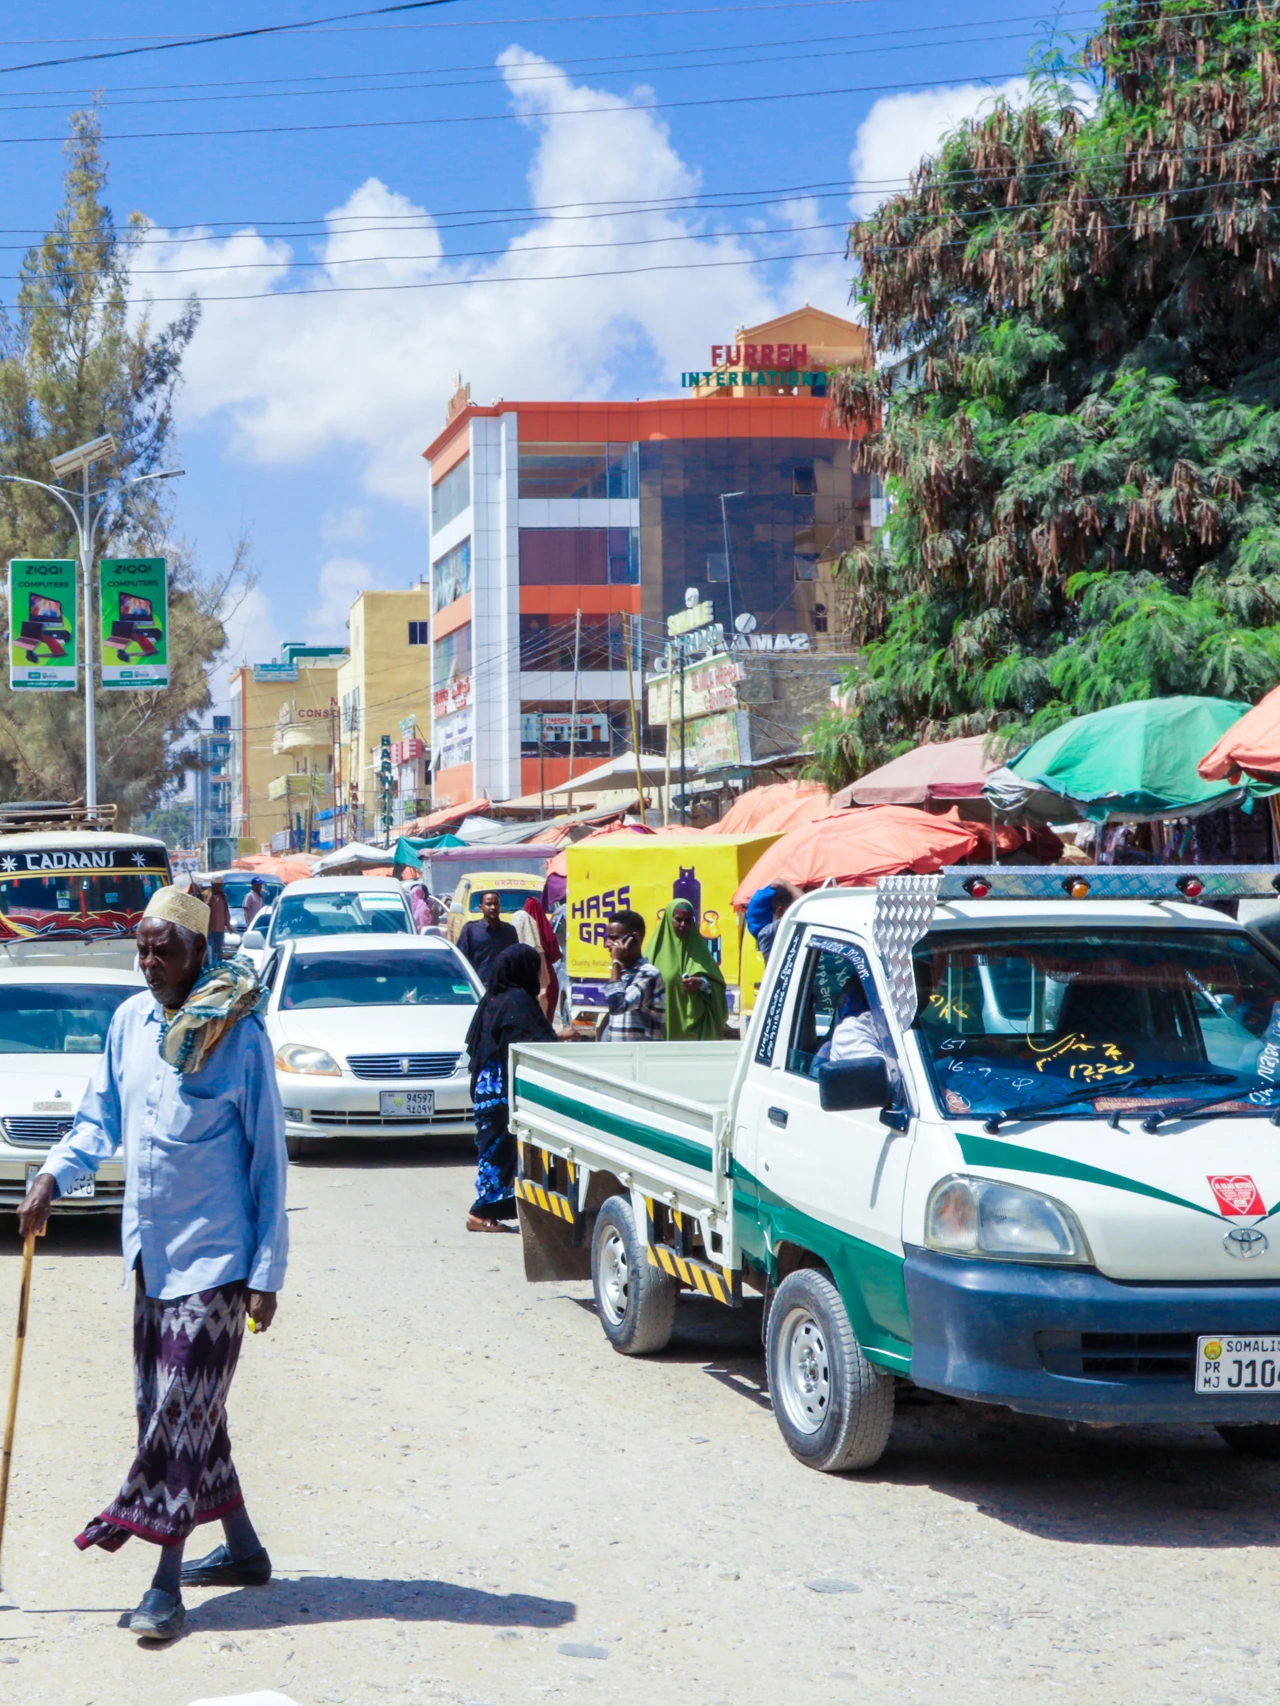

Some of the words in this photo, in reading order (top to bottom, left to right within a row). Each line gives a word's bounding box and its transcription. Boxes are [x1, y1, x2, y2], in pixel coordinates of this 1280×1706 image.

[711, 344, 807, 367] FURREH
[681, 371, 828, 388] INTERNATIONA
[25, 565, 63, 576] ZIQQI
[114, 564, 152, 574] ZIQQI
[107, 579, 159, 587] COMPUTERS
[572, 885, 631, 919] HASS
[579, 922, 608, 949] GA
[406, 1093, 433, 1103] 94597
[1226, 1340, 1280, 1353] SOMALI
[1205, 1361, 1221, 1374] PR
[1227, 1359, 1280, 1388] J10
[1203, 1376, 1221, 1389] MJ
